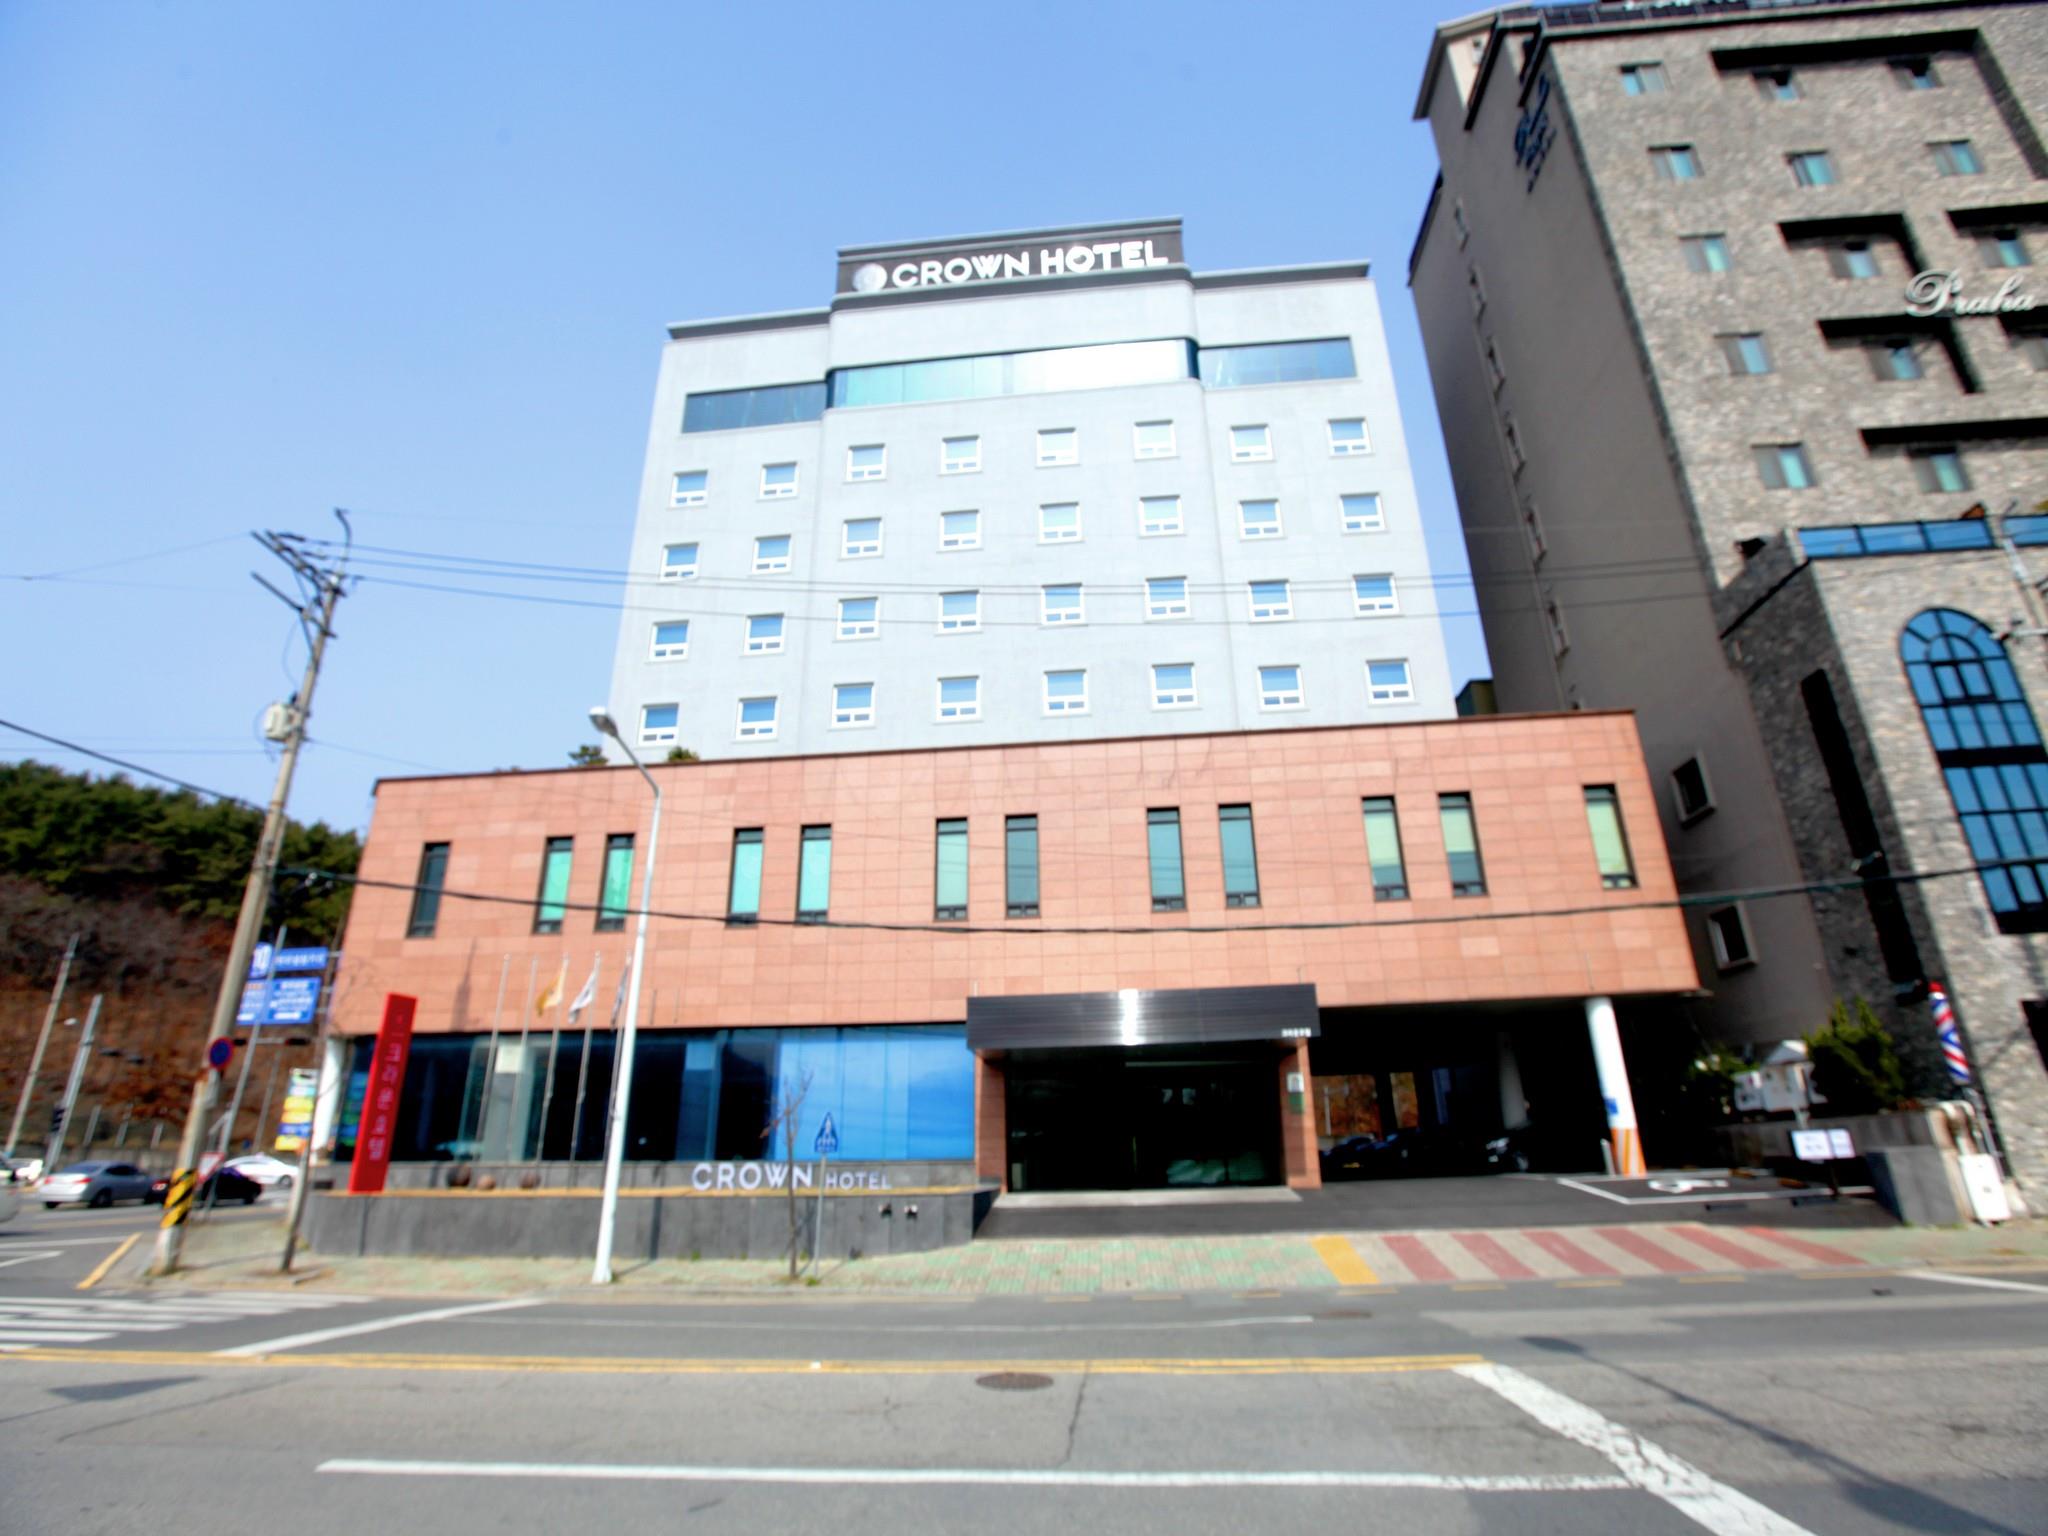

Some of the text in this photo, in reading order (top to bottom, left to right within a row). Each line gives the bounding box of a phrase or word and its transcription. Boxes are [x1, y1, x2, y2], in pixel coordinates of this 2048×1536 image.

[892, 240, 1168, 288] CROWN HOTEL
[1904, 268, 2035, 317] Praha
[691, 1162, 892, 1190] CROWN HOTEL
